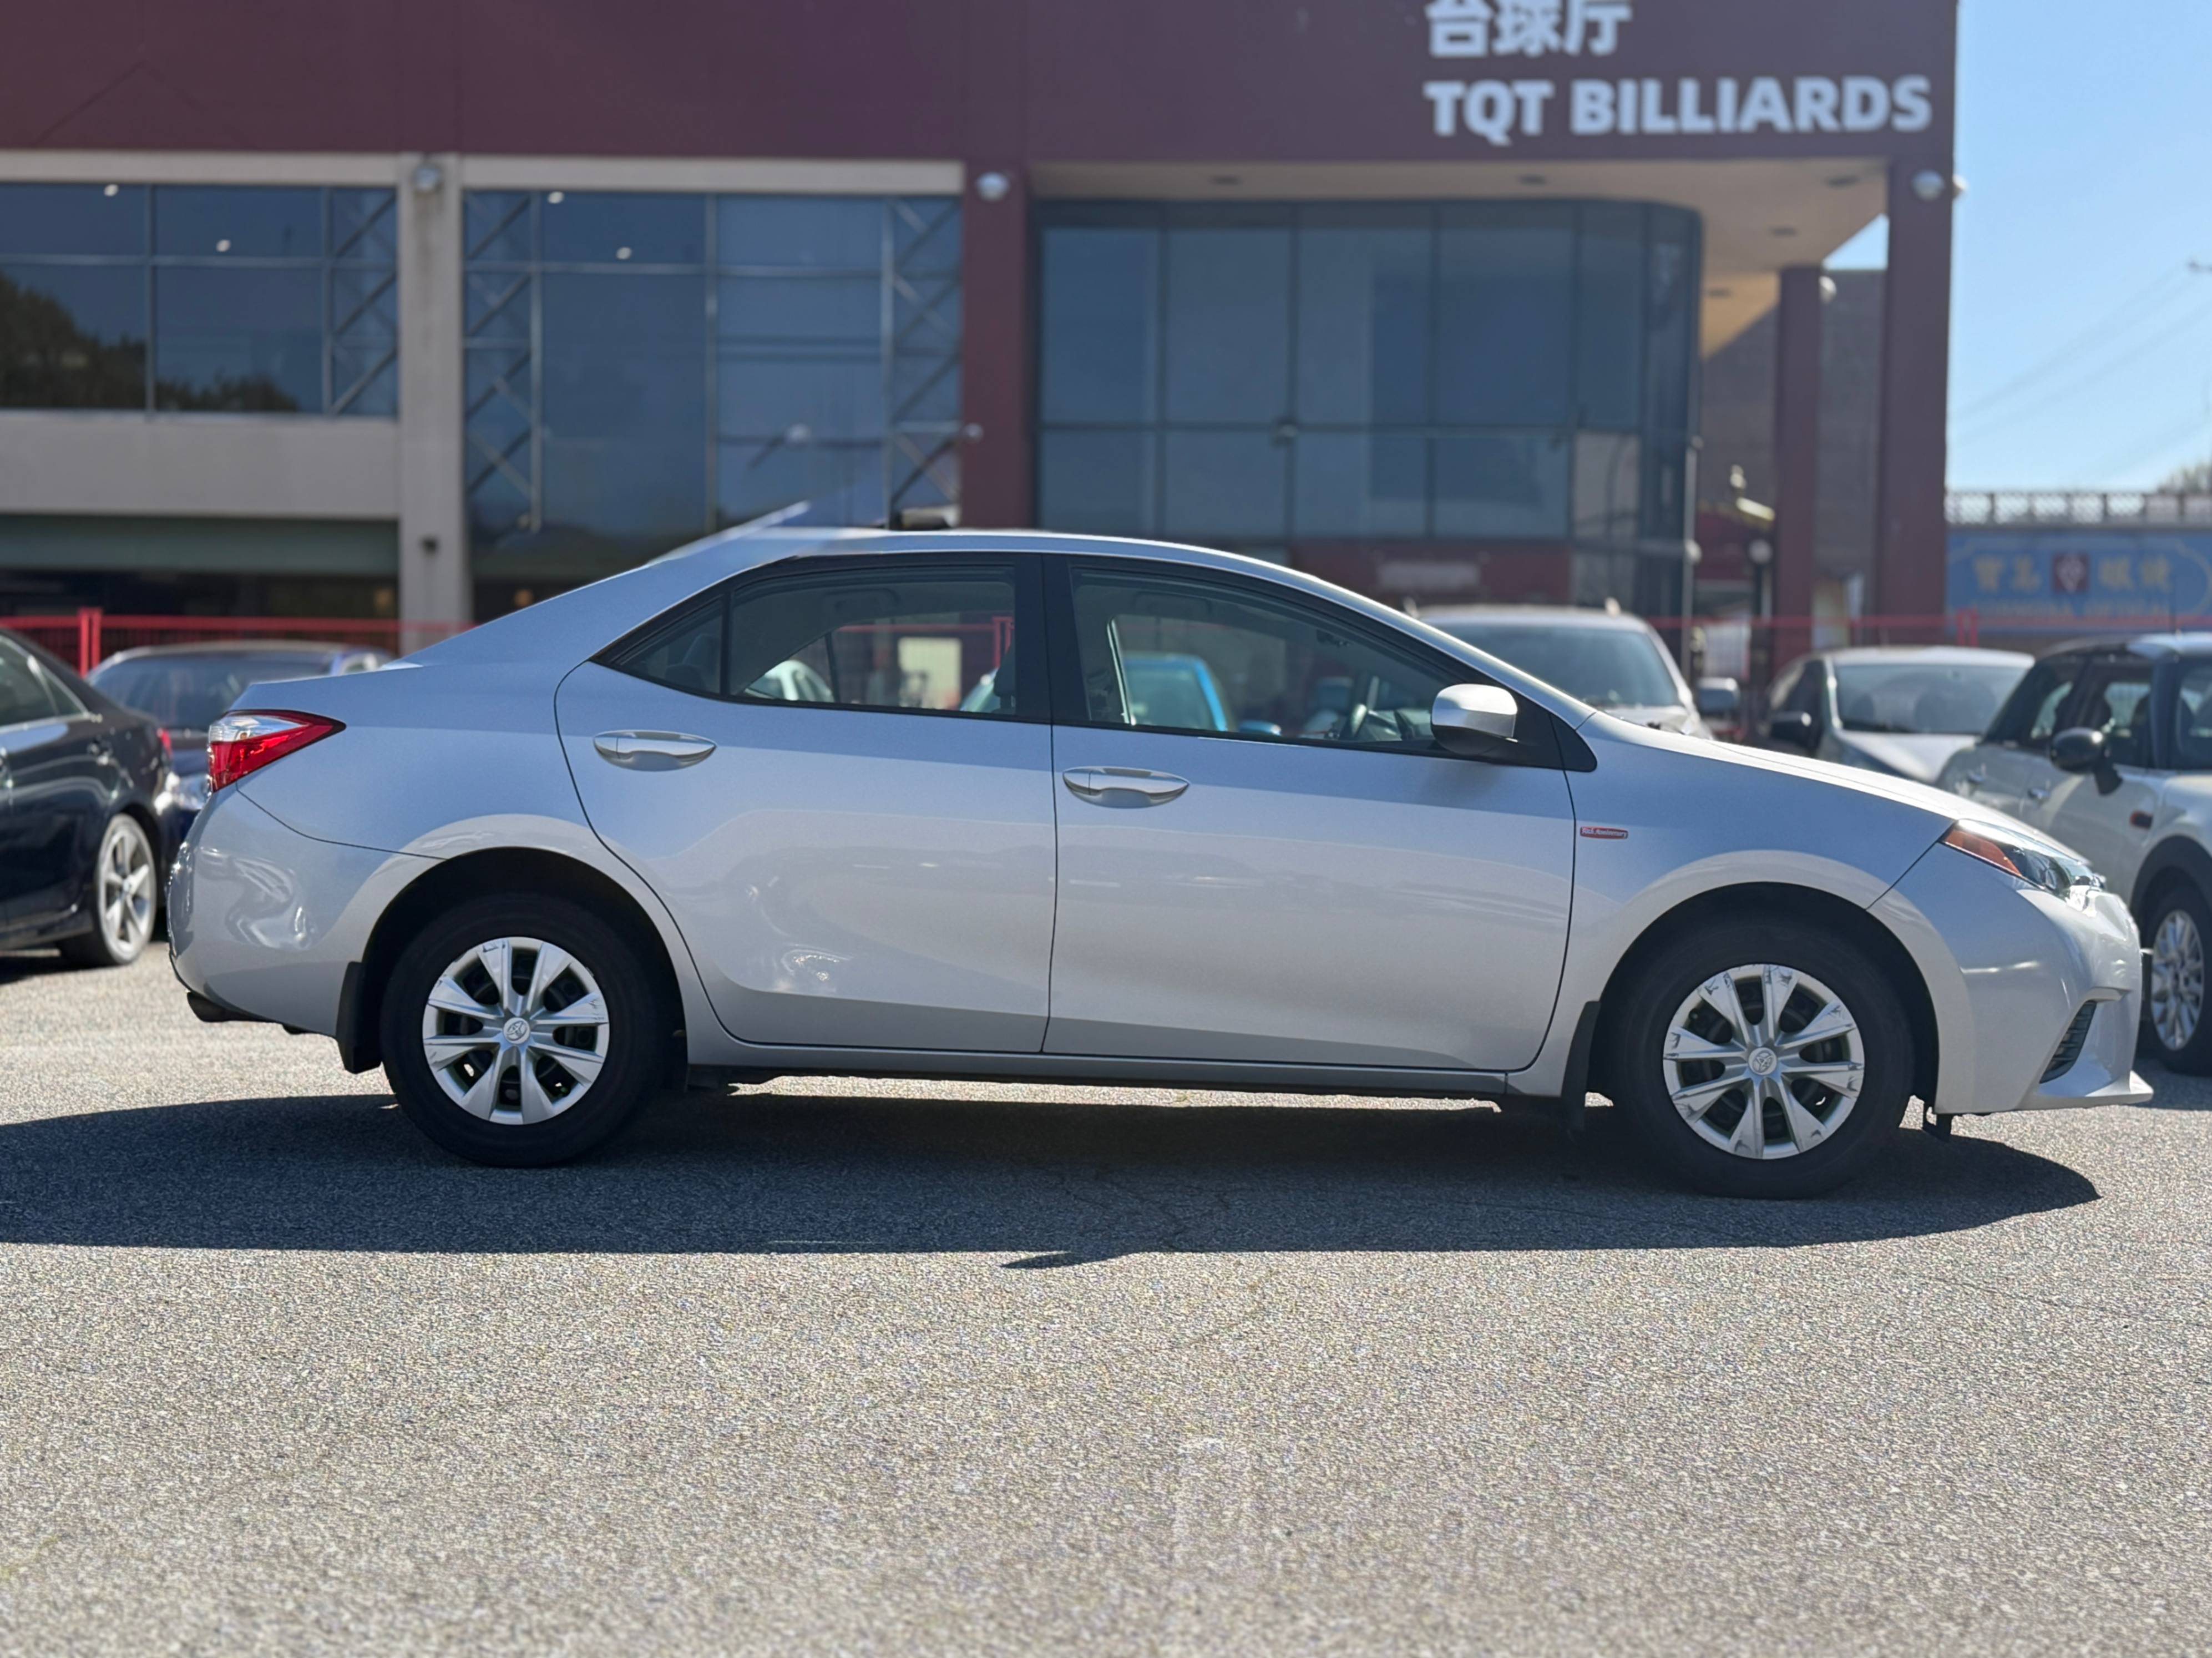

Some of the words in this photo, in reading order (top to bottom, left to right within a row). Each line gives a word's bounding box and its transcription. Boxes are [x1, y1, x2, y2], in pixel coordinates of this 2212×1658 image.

[1425, 0, 1632, 57] 台球厅
[1423, 80, 1555, 145] TQT
[1571, 75, 1931, 134] BILLIARDS
